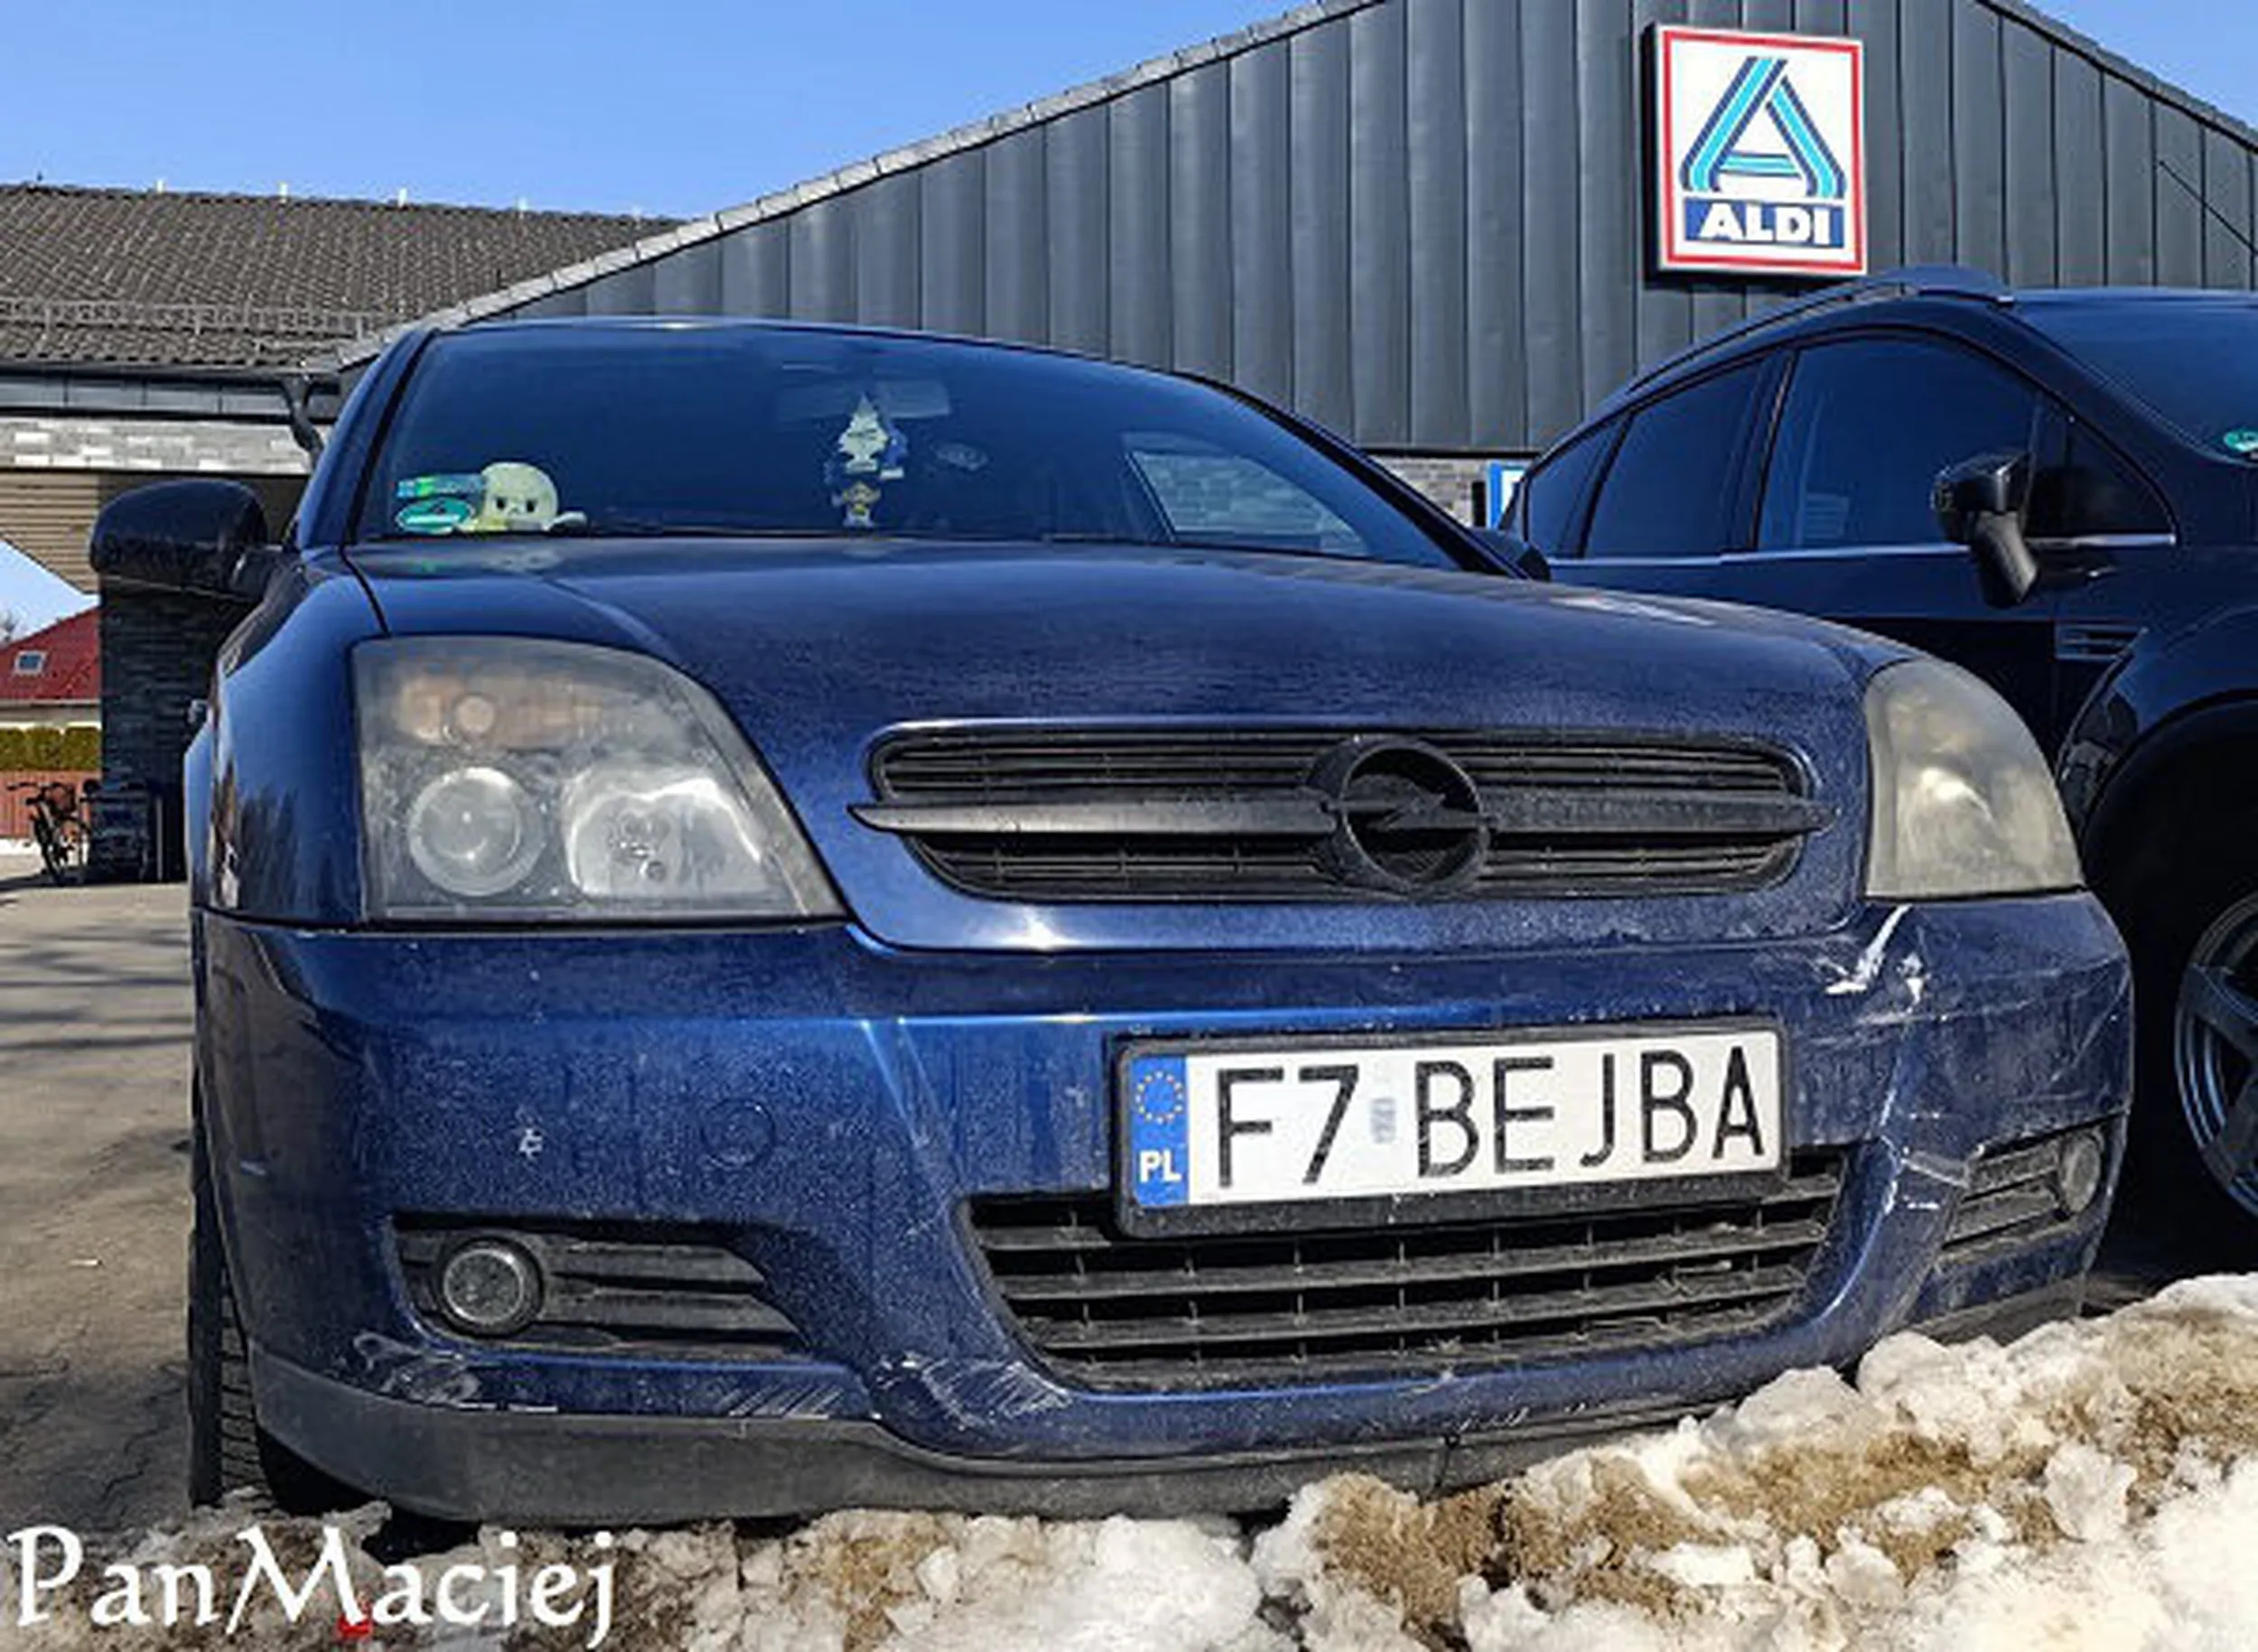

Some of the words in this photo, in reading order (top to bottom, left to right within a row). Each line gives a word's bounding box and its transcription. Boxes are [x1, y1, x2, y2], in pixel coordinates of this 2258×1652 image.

[1698, 202, 1831, 246] ALDI
[1217, 1063, 1359, 1188] F7
[1414, 1046, 1766, 1179] BEJBA
[1138, 1148, 1182, 1183] PL
